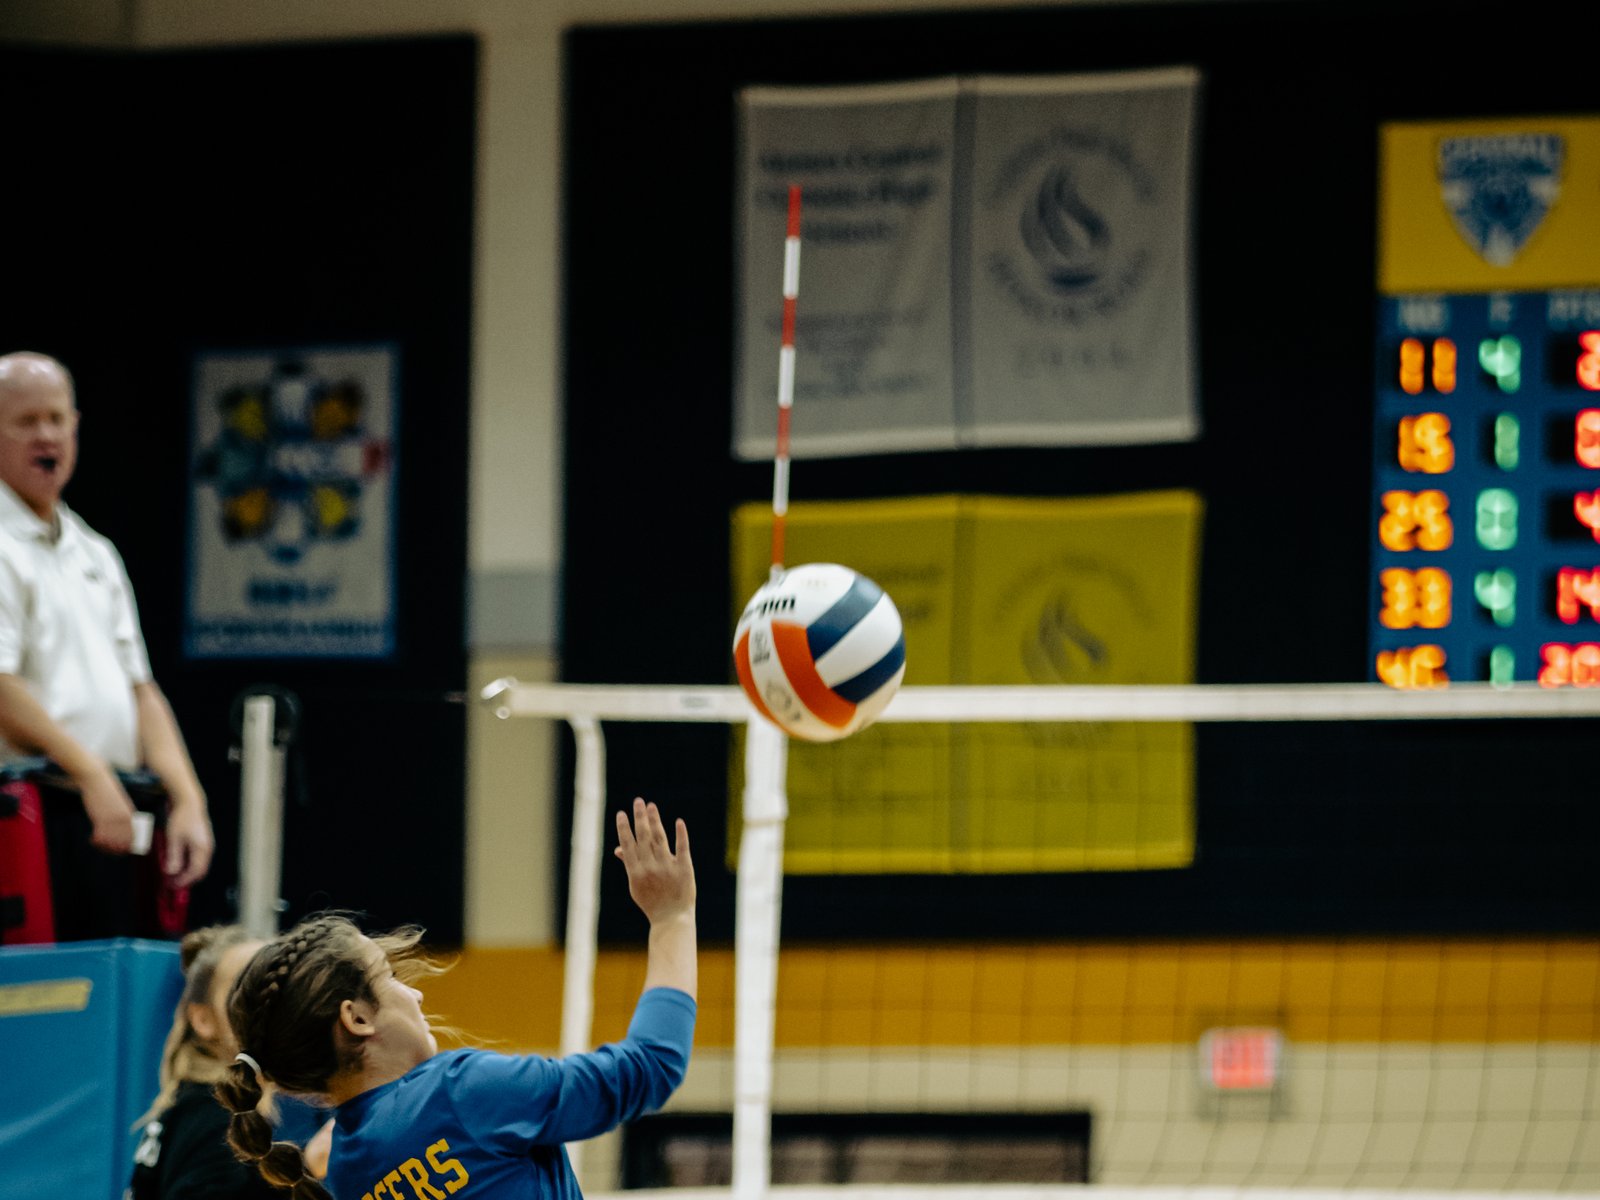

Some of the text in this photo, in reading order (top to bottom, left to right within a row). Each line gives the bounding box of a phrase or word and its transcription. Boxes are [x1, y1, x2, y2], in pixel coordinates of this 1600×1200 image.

[1399, 337, 1457, 394] 11
[1478, 335, 1522, 394] 4
[1397, 411, 1455, 474] 15
[1495, 413, 1520, 472] 1
[1378, 488, 1454, 552] 25
[1474, 567, 1516, 628] 4
